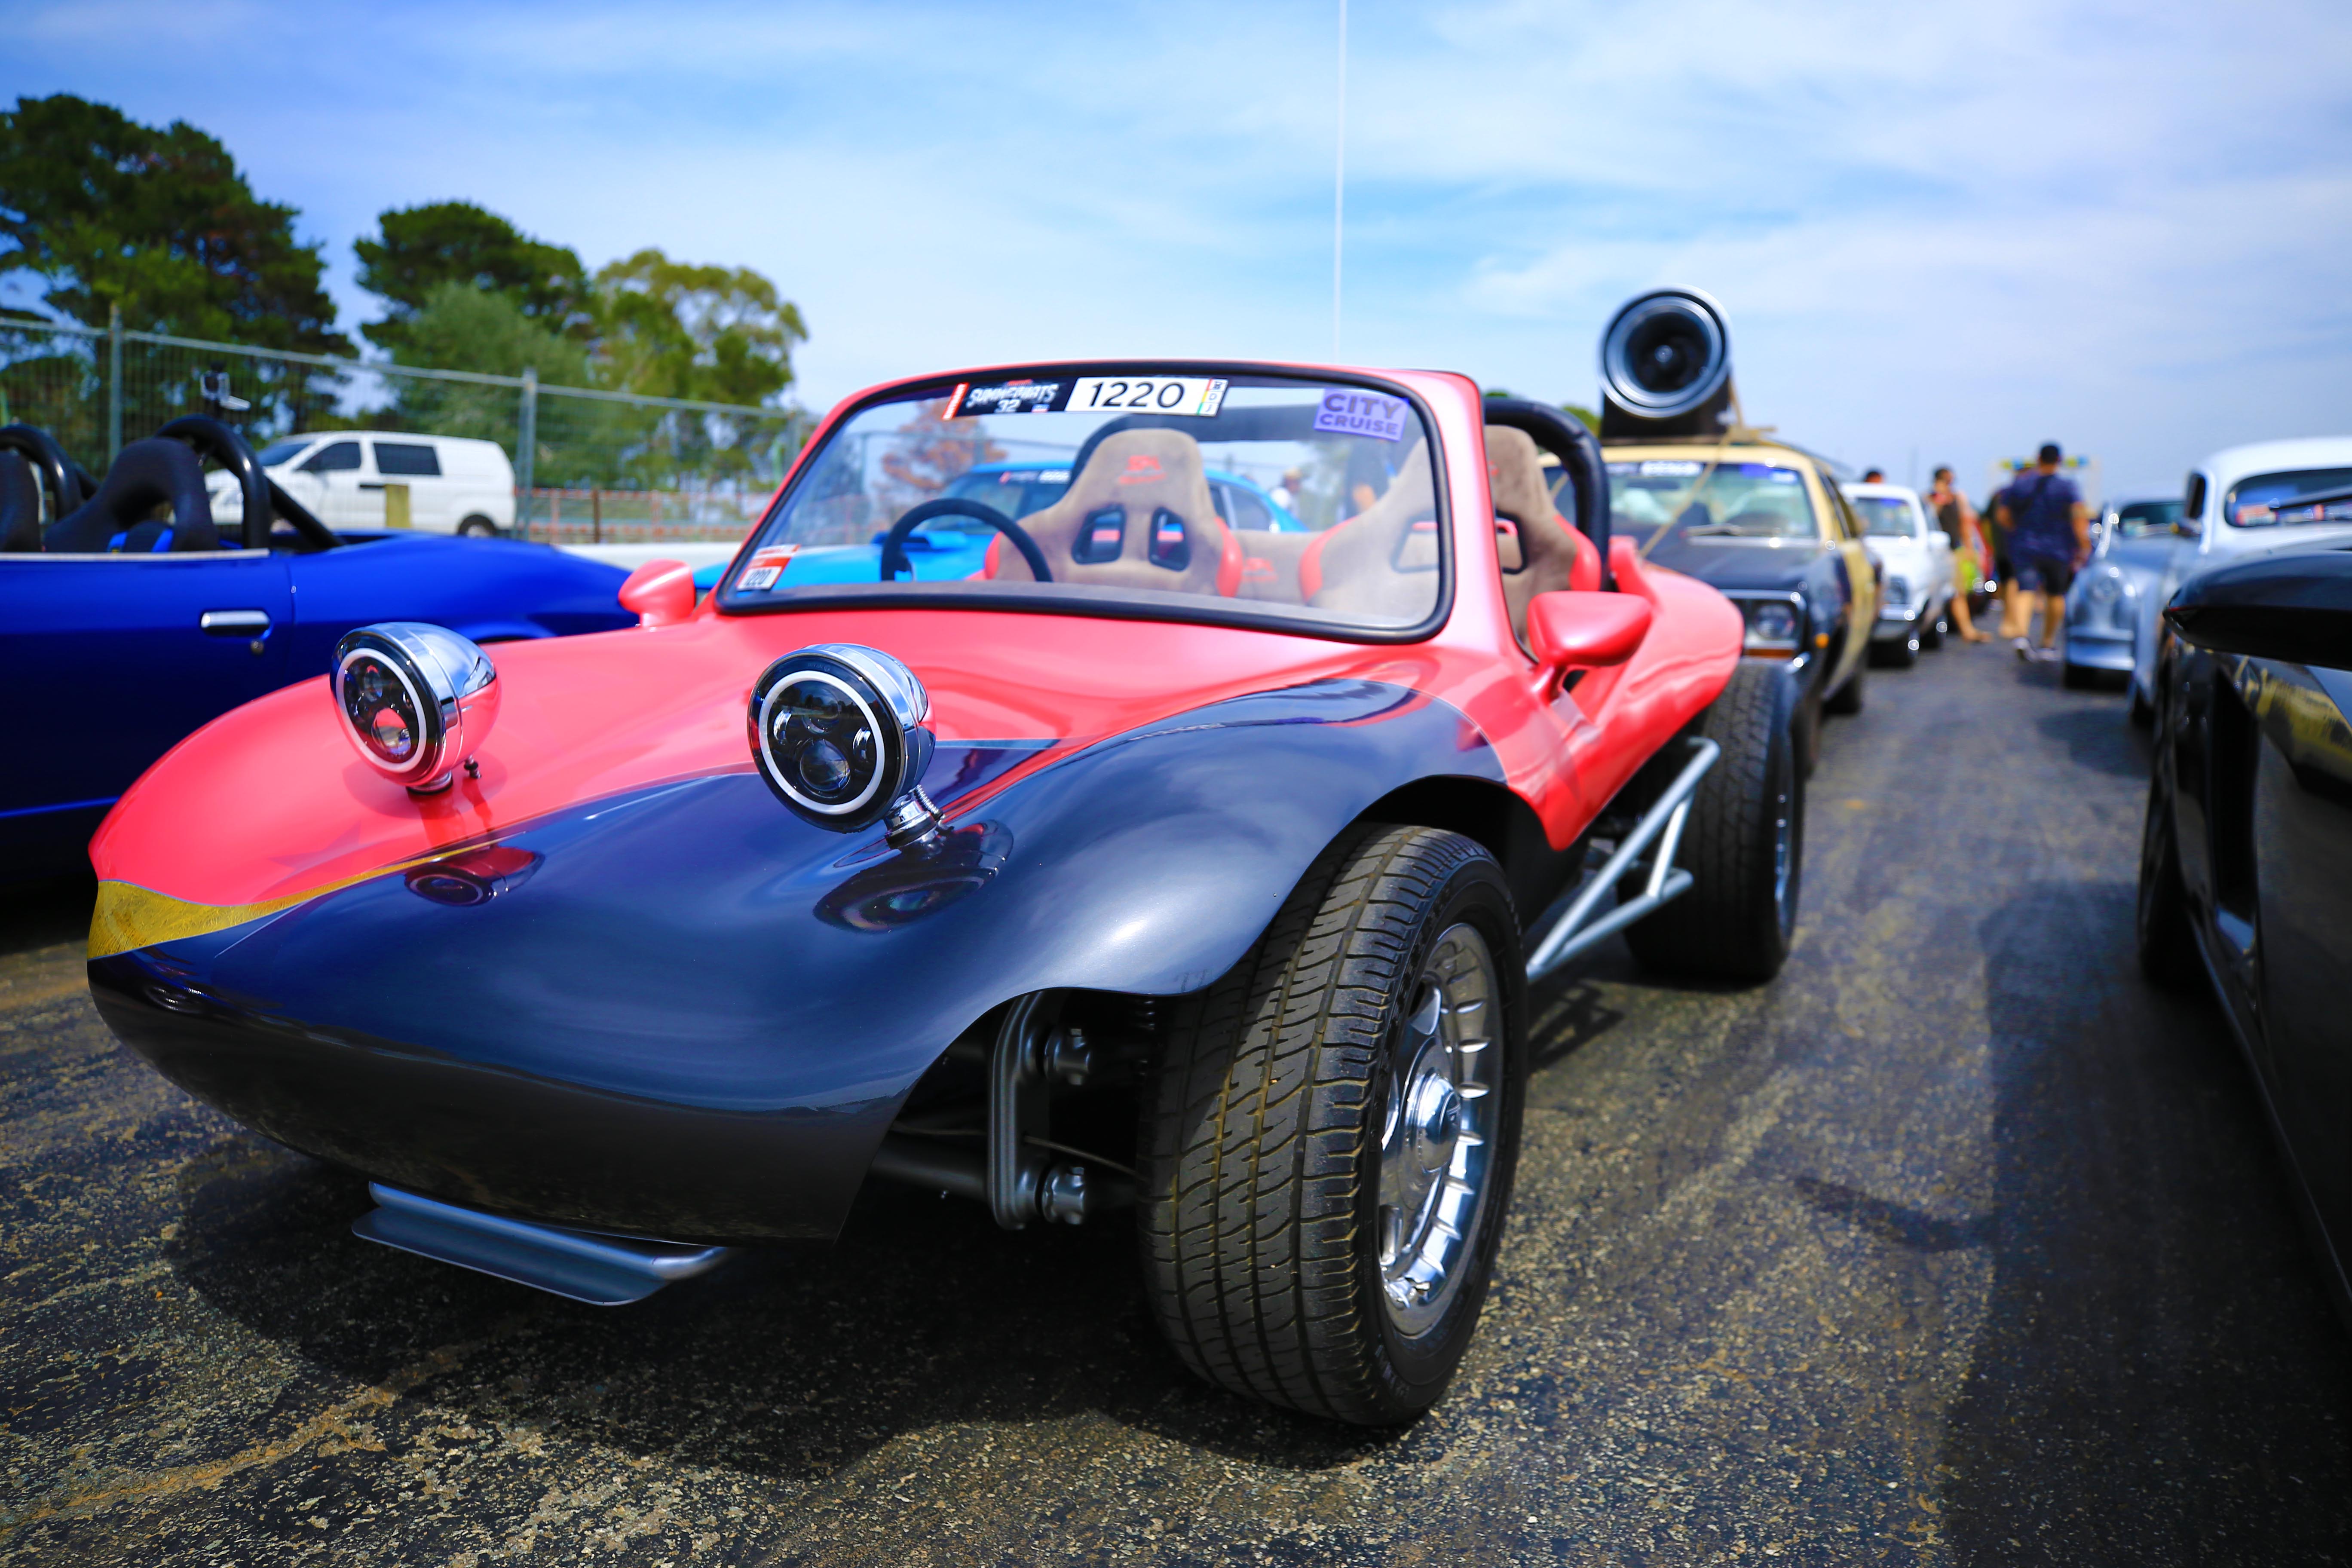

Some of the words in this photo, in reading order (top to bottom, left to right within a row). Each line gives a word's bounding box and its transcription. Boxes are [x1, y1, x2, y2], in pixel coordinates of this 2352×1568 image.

[994, 399, 1022, 413] 32
[1089, 381, 1185, 408] 1220
[1325, 394, 1401, 419] CITY
[1320, 413, 1399, 435] CRUISE
